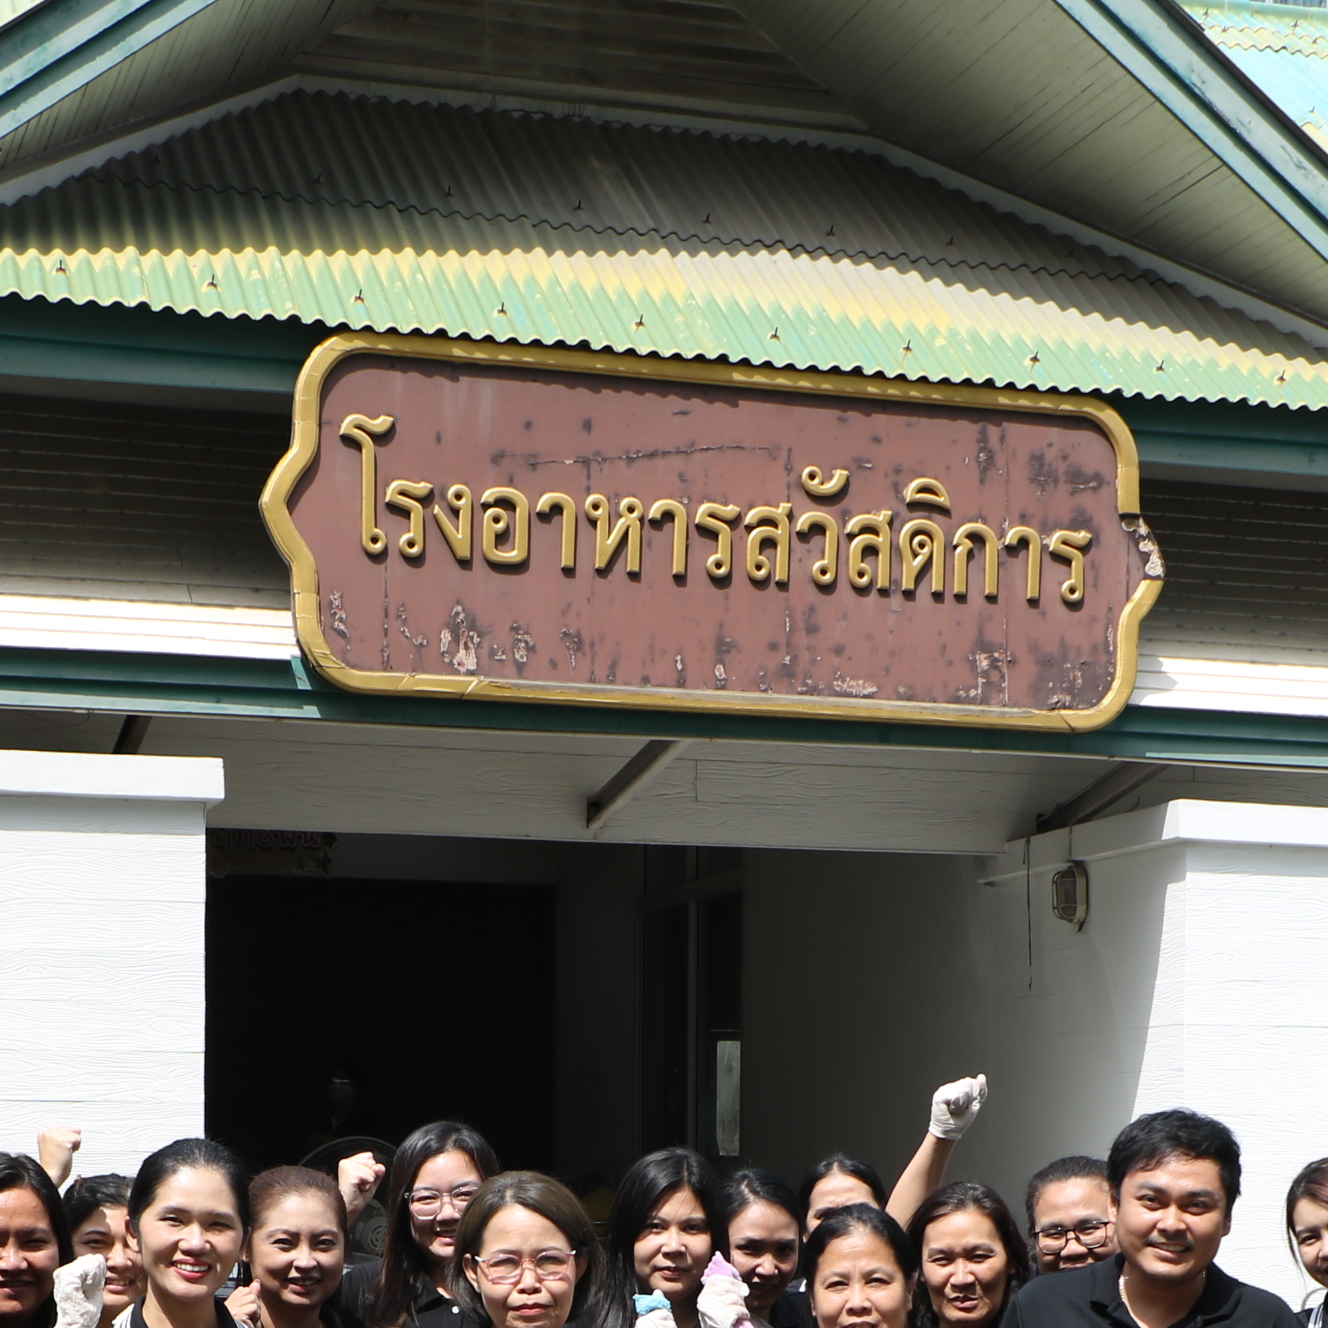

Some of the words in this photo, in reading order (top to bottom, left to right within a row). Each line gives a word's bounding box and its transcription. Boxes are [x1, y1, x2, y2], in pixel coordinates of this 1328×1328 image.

[339, 412, 1093, 607] โรงอาหารสวัสดิการ
